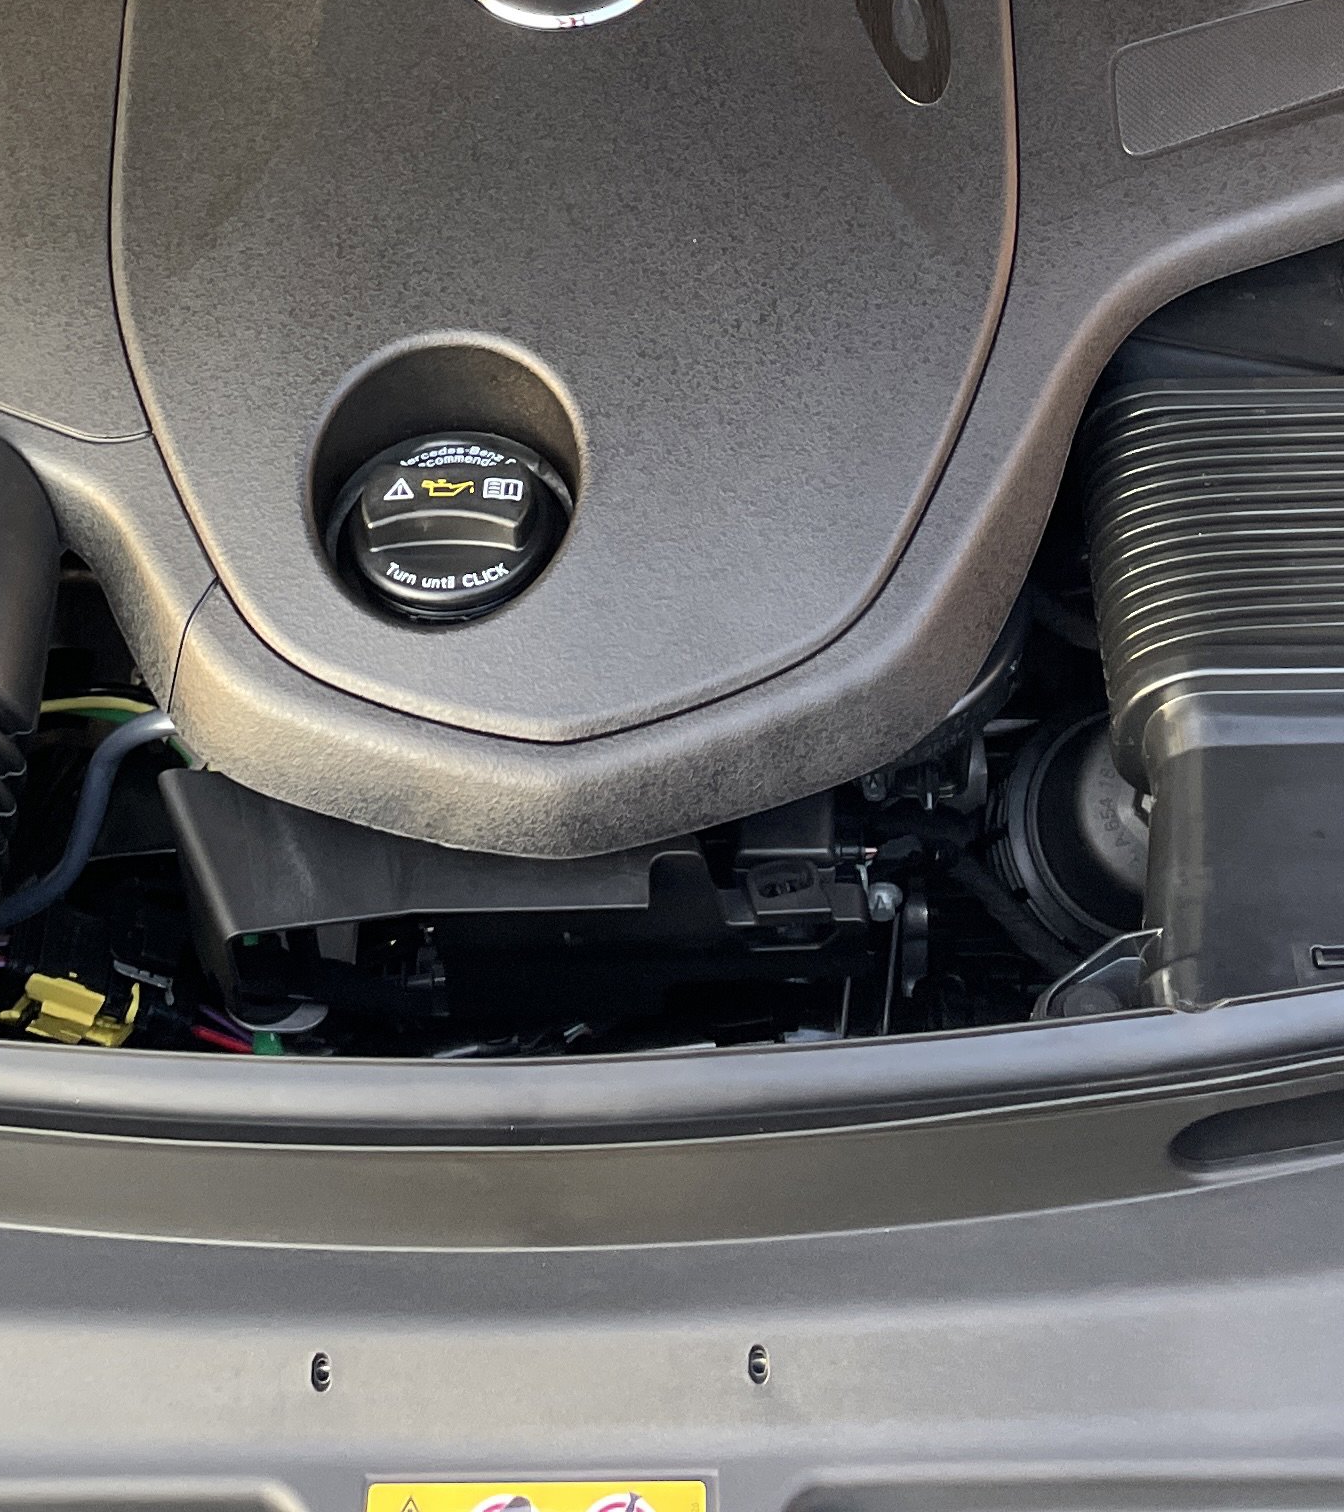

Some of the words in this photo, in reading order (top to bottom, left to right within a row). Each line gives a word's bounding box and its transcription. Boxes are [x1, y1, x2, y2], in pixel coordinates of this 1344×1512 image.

[386, 561, 417, 586] Turn
[421, 575, 456, 589] until
[461, 561, 510, 588] CLICK
